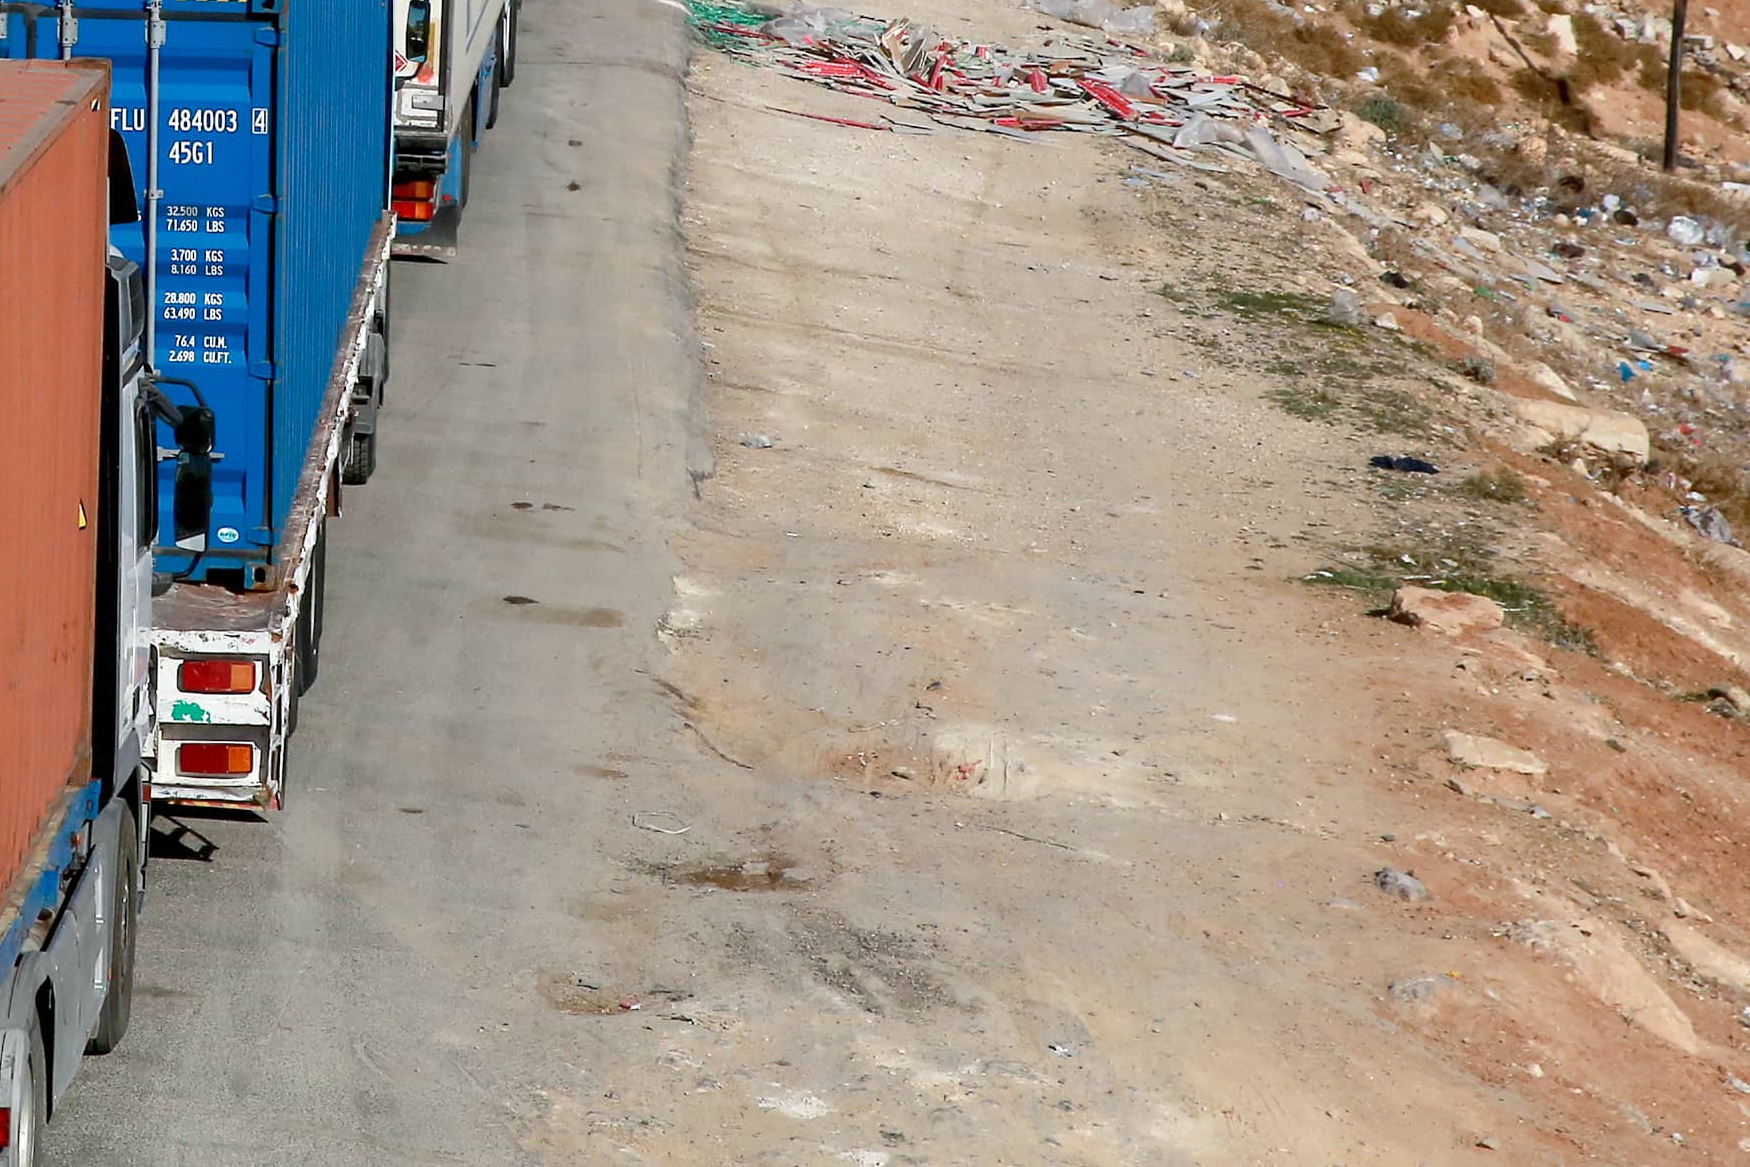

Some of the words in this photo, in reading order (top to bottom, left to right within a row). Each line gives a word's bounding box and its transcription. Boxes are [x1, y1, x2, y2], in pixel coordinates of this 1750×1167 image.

[168, 108, 238, 133] 484003
[253, 109, 267, 133] 4
[169, 140, 214, 165] 45G1
[166, 205, 198, 217] 32.500
[206, 207, 225, 218] KGS
[166, 219, 198, 232] 71.650
[206, 220, 225, 232] LBS
[171, 248, 197, 262] 3.700
[205, 249, 224, 262] KGS
[171, 264, 197, 275] 8.160
[205, 265, 224, 276] LBS
[164, 292, 196, 305] 28.800
[204, 293, 224, 305] KGS
[163, 307, 196, 320] 63.490
[203, 308, 223, 321] LBS
[174, 335, 196, 348] 76.4
[168, 350, 195, 363] 2.698
